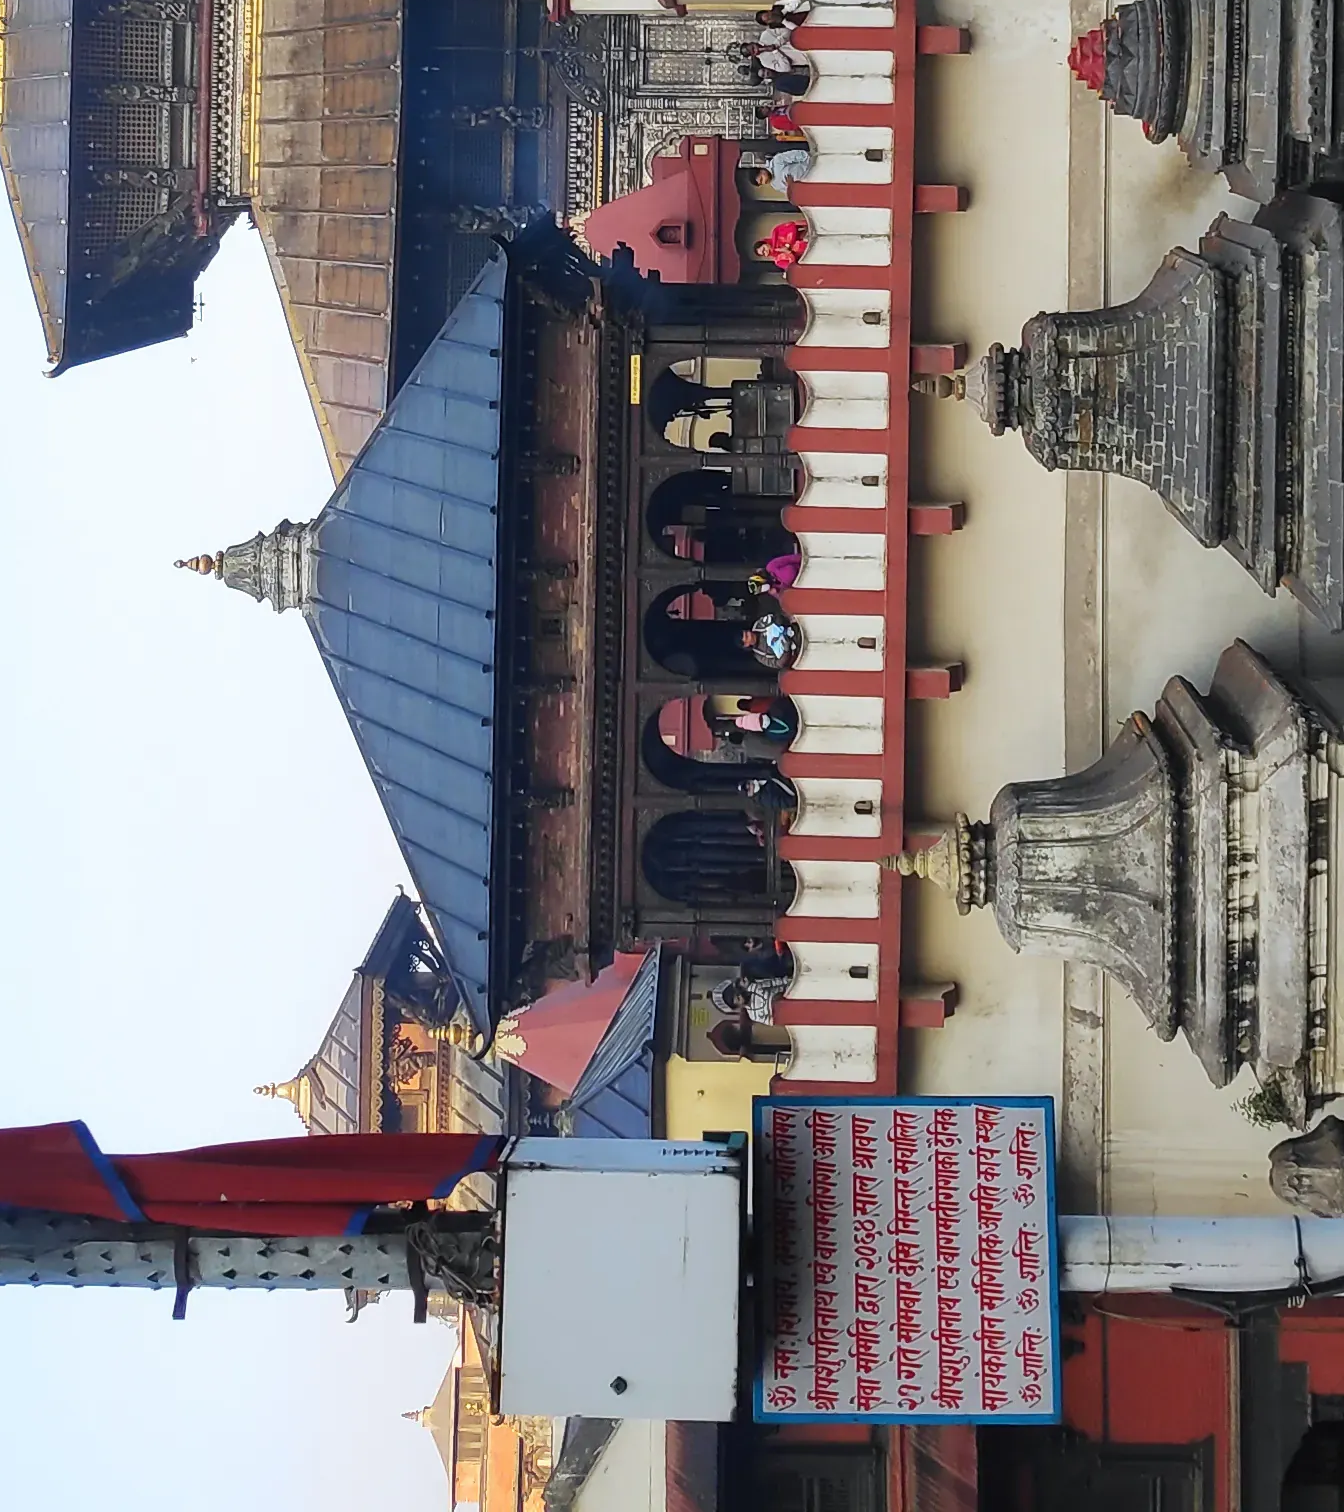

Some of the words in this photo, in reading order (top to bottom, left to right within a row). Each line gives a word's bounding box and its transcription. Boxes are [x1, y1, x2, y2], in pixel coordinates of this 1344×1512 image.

[805, 1109, 843, 1159] आरति
[851, 1114, 880, 1170] श्रावण
[887, 1110, 925, 1175] संचालित
[926, 1108, 962, 1148] दैनिक
[968, 1145, 1003, 1182] कार्य
[852, 1172, 885, 1217] साल
[887, 1177, 926, 1236] निरन्तर
[969, 1183, 1008, 1234] आरति
[1013, 1184, 1037, 1209] ॐ
[808, 1260, 838, 1287] एवं
[854, 1272, 886, 1314] द्वारा
[930, 1265, 960, 1292] एवं
[889, 1278, 928, 1344] सोमबार
[1016, 1288, 1040, 1314] ॐ
[847, 1318, 886, 1374] समिति
[889, 1346, 929, 1380] गते
[972, 1314, 1012, 1411] सायंकालीन
[849, 1376, 888, 1411] सेवा
[1018, 1384, 1042, 1408] ॐ
